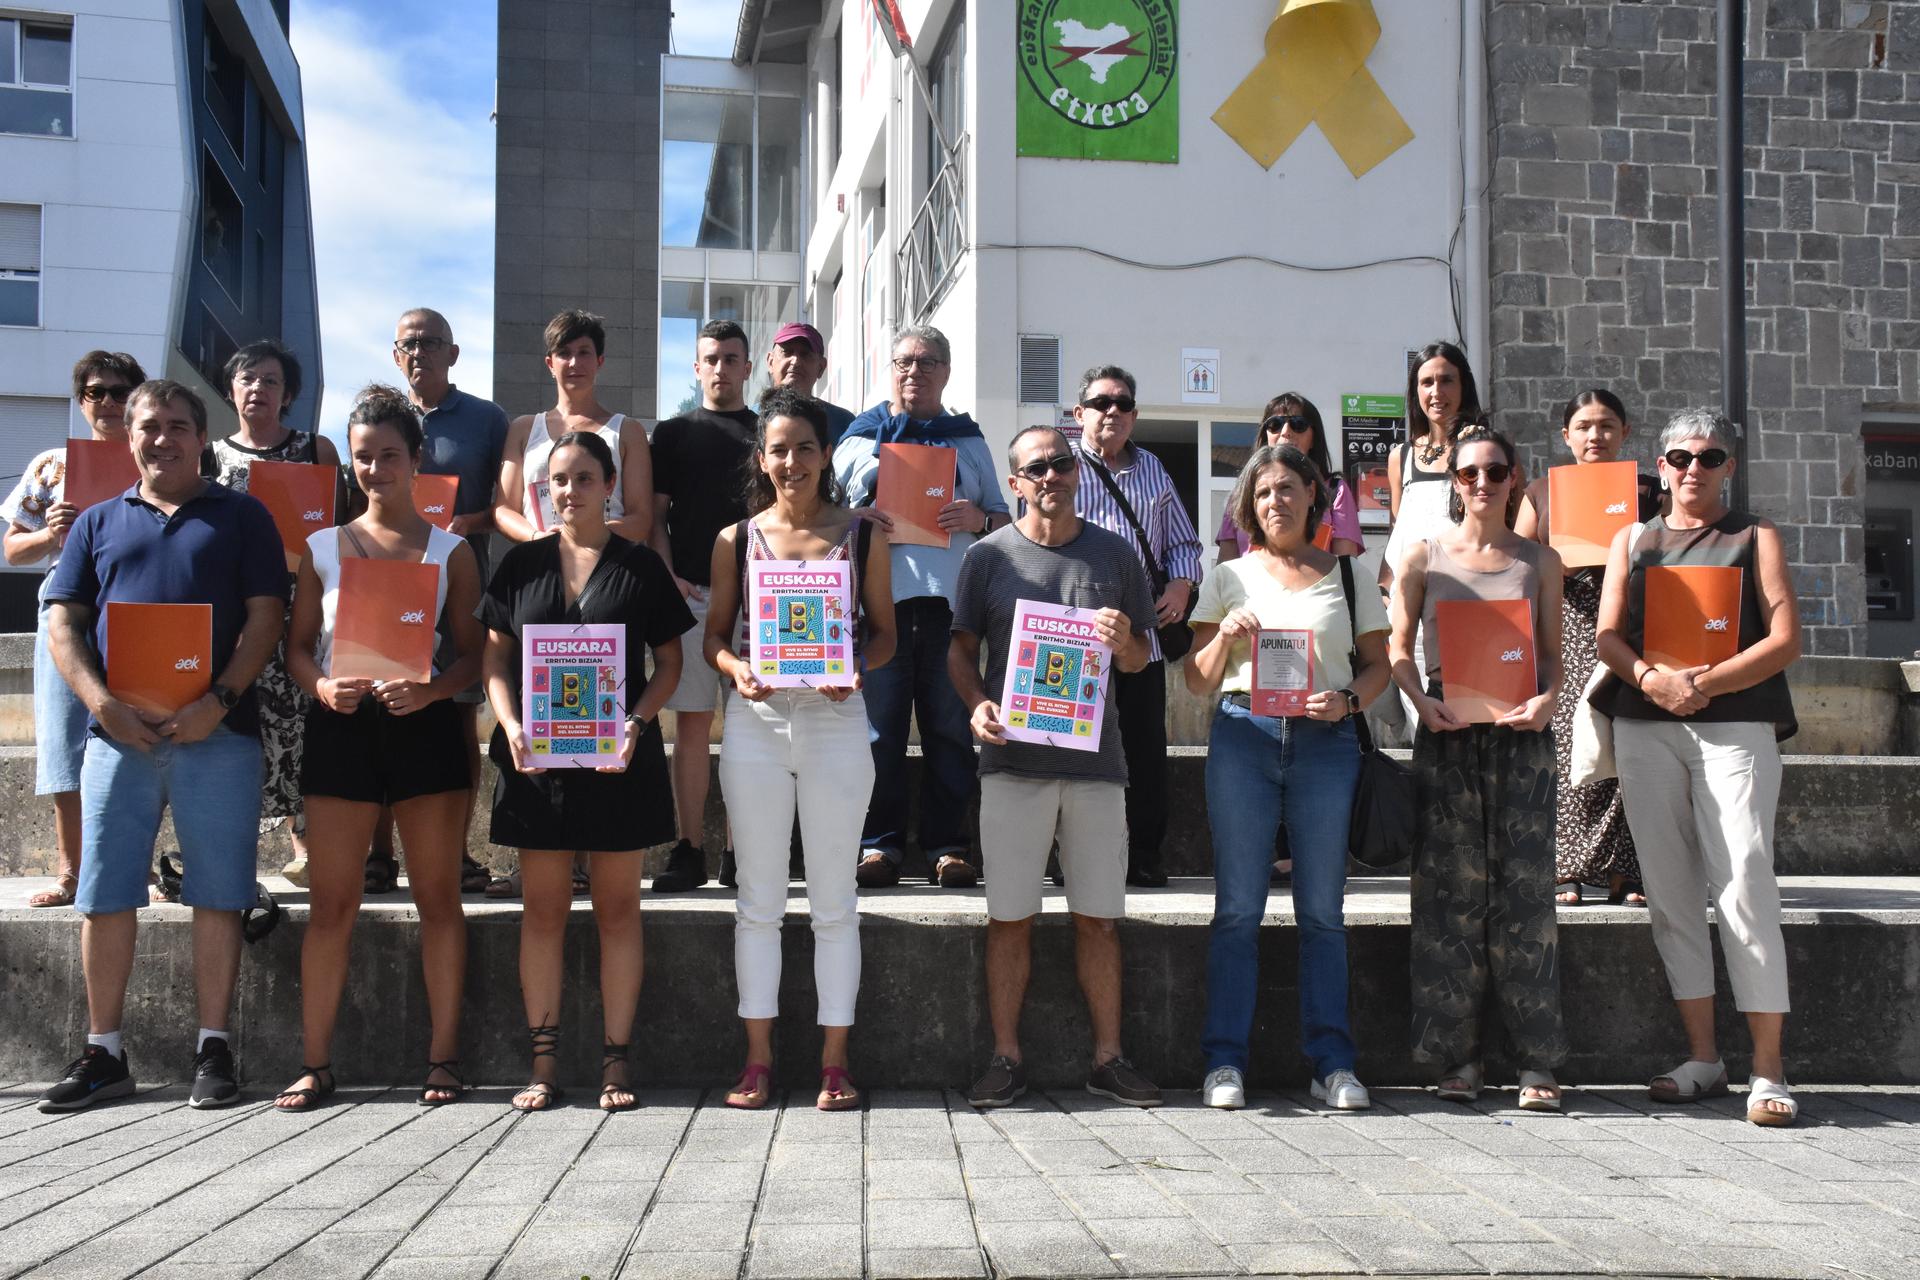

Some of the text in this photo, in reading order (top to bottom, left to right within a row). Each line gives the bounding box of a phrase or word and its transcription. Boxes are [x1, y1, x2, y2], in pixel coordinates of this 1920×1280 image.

[1050, 87, 1149, 126] etxera
[1865, 450, 1920, 469] xaban
[926, 485, 945, 497] aek
[423, 504, 445, 513] aek
[1605, 501, 1628, 513] aek
[303, 508, 325, 521] aek
[763, 575, 838, 585] EUSKARA
[400, 609, 425, 623] aek
[1027, 617, 1101, 638] EUSKARA
[1704, 616, 1729, 631] aek
[537, 641, 612, 653] EUSKARA
[1034, 634, 1091, 647] ERRITMO BIZIAN
[1501, 646, 1524, 661] aek
[175, 655, 200, 670] aek
